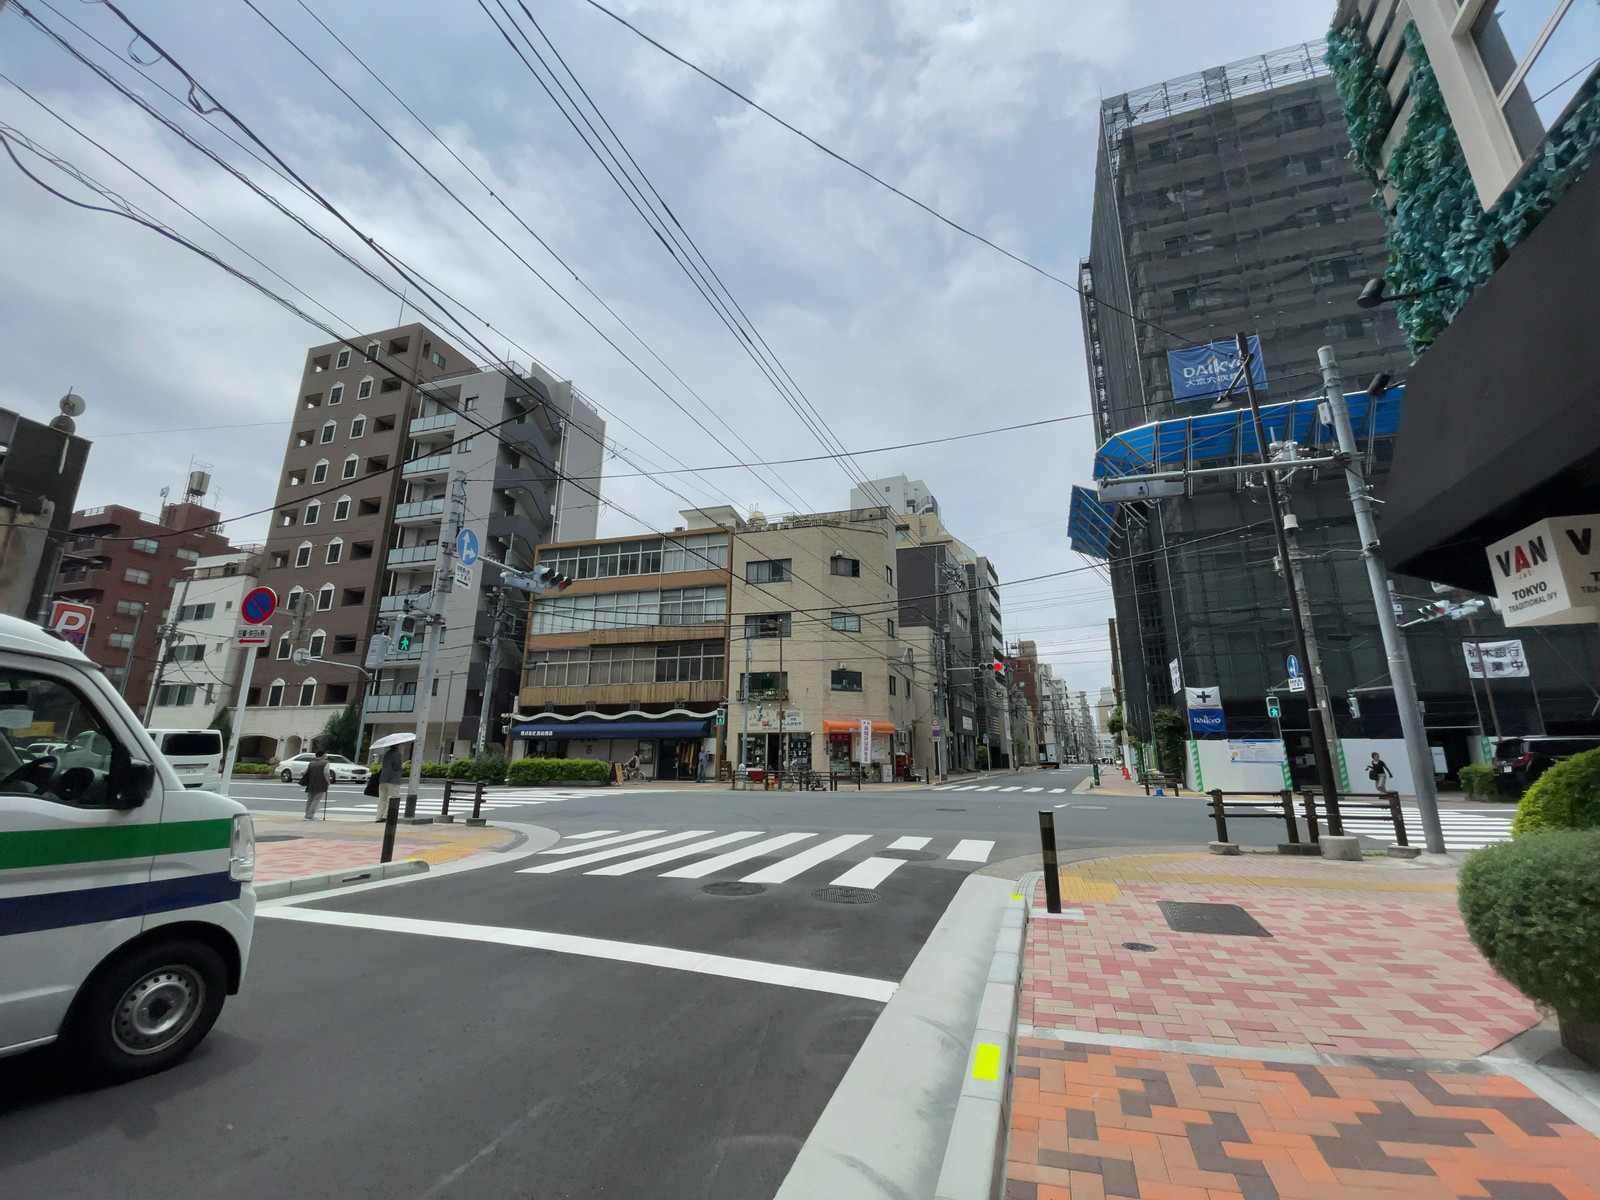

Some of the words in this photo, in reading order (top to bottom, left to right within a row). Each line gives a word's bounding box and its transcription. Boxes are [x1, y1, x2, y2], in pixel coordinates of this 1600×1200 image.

[1495, 535, 1548, 578] VAN
[1511, 581, 1548, 601] TOKYO
[1508, 596, 1547, 614] TRADITIONAL
[1546, 591, 1559, 601] IVY
[54, 610, 87, 633] P
[1466, 645, 1521, 659] 栃木銀行
[1470, 660, 1524, 673] 営業中
